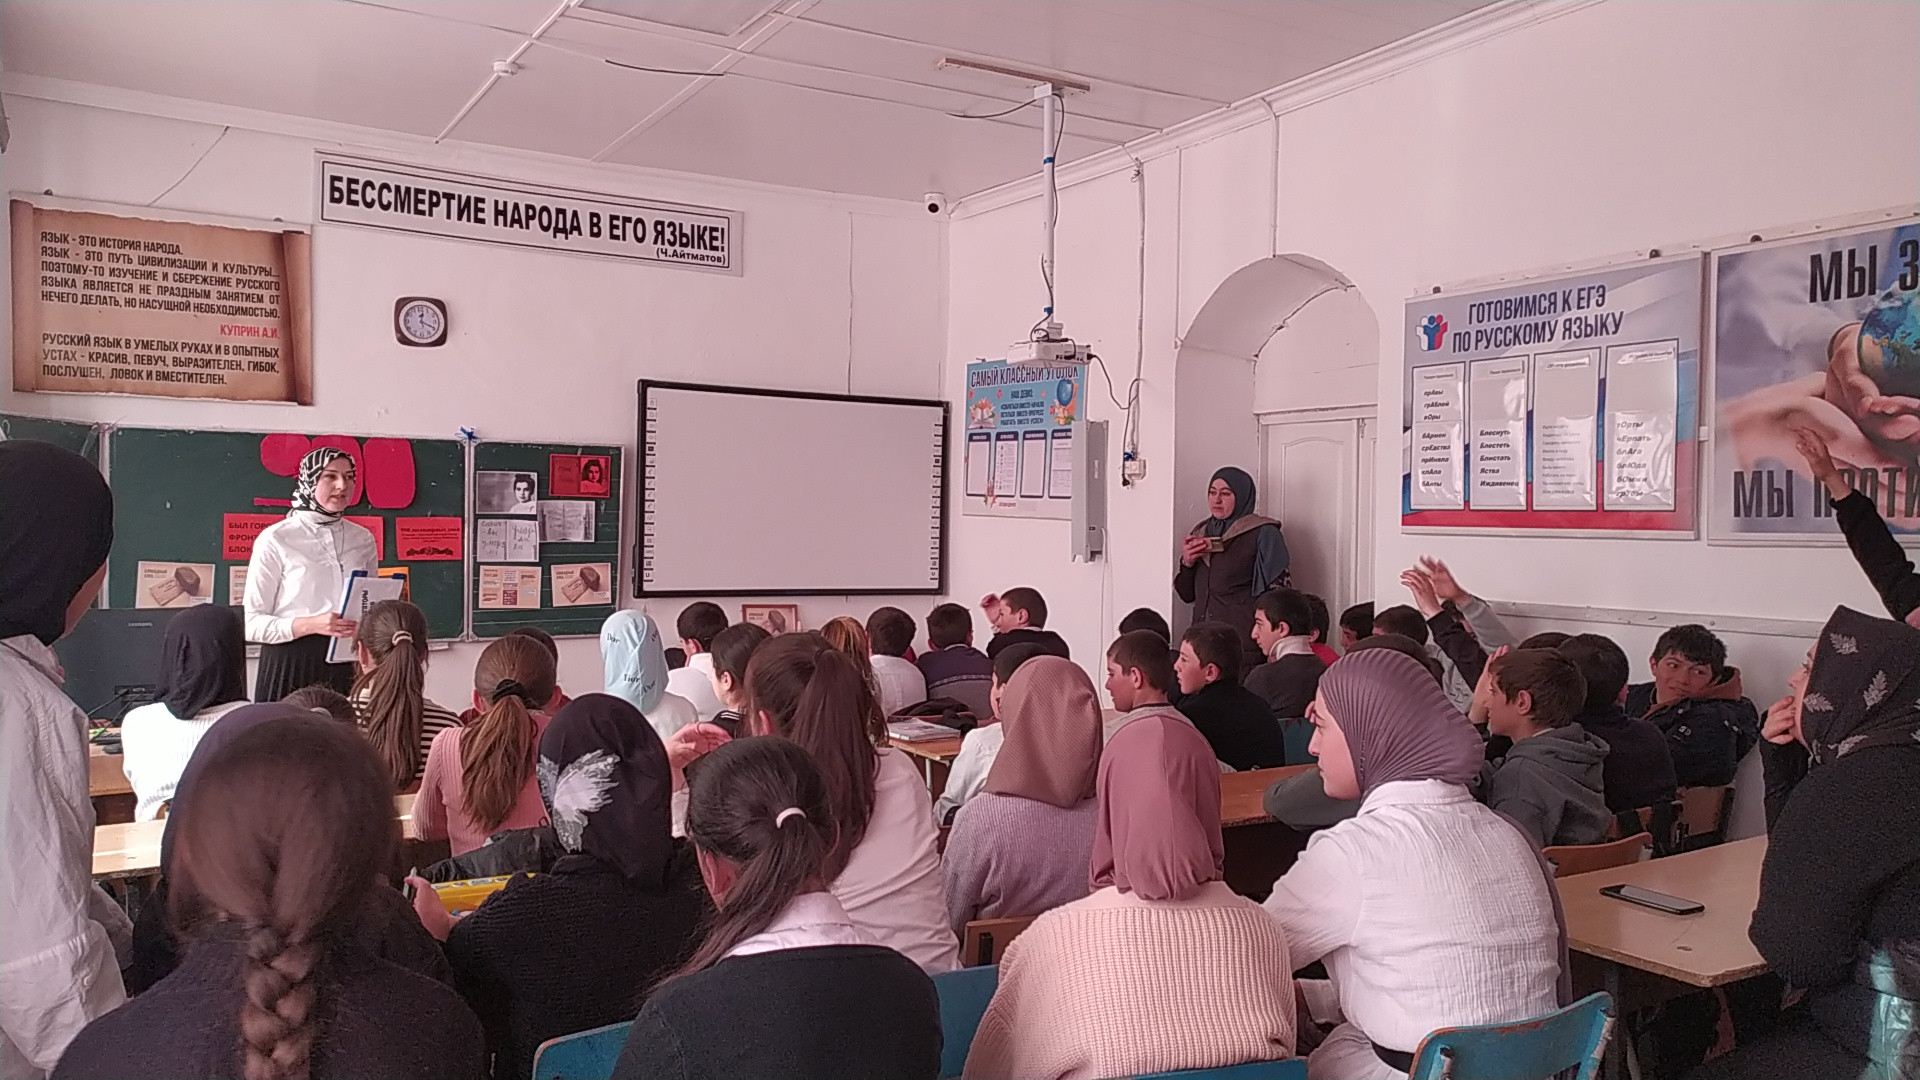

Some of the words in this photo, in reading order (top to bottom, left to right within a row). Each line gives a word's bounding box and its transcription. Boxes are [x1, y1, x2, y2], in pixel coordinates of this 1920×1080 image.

[329, 174, 486, 225] БЕССМЕРТИЕ
[494, 199, 583, 240] НАРОДА
[589, 211, 601, 238] В
[609, 214, 646, 244] ЕГО
[653, 220, 725, 252] ЯЗЫКЕ!
[41, 231, 70, 244] ЯЗЫК
[78, 235, 97, 247] ЭТО
[99, 237, 141, 251] ИСТОРИЯ
[143, 241, 183, 255] НАРОДА.
[656, 247, 726, 265] (Ч.Айтматов)
[41, 246, 70, 259] ЯЗЫК
[84, 250, 103, 262] ЭТО
[108, 252, 133, 264] ПУТЬ
[138, 255, 207, 271] ЦИВИЛИЗАЦИИ
[212, 262, 218, 272] И
[41, 261, 105, 276] ПОЭТОМУ-ТО
[109, 267, 159, 281] ИЗУЧЕНИЕ
[162, 271, 168, 282] И
[173, 272, 232, 287] СБЕРЕЖЕНИЕ
[236, 278, 280, 291] РУССКОГО
[1809, 245, 1877, 303] МЫ
[41, 276, 77, 289] ЯЗЫКА
[83, 280, 133, 293] ЯВЛЯЕТСЯ
[139, 284, 151, 295] НЕ
[157, 285, 211, 299] ПРАЗДНЫМ
[216, 290, 264, 303] ЗАНЯТИЕМ
[269, 294, 280, 305] ОТ
[41, 291, 78, 303] НЕЧЕГО
[80, 294, 122, 308] ДЕЛАТЬ,
[124, 297, 137, 308] НО
[139, 298, 191, 312] НАСУЩНОЙ
[193, 303, 280, 319] НЕОБХОДИМОСТЬЮ.
[1469, 291, 1558, 325] ГОТОВИМСЯ
[1562, 289, 1573, 312] К
[1576, 285, 1606, 310] ЕГЭ
[42, 333, 91, 347] РУССКИЙ
[93, 336, 122, 349] ЯЗЫК
[125, 338, 131, 349] В
[133, 339, 179, 352] УМЕЛЫХ
[181, 342, 213, 354] РУКАХ
[215, 344, 221, 355] И
[224, 345, 230, 355] В
[232, 345, 279, 358] ОПЫТНЫХ
[220, 325, 260, 337] КУПРИН
[262, 327, 280, 339] А.И.
[1453, 331, 1471, 353] ПО
[1475, 320, 1559, 351] РУССКОМУ
[1562, 311, 1624, 340] ЯЗЫКУ
[42, 364, 105, 379] ПОСЛУШЕН,
[110, 368, 143, 380] ЛОВОК
[146, 370, 153, 380] И
[155, 370, 227, 385] ВМЕСТИТЕЛЕН.
[43, 349, 77, 361] УСТАХ
[88, 351, 131, 365] КРАСИВ,
[134, 354, 168, 367] ПЕВУЧ,
[172, 356, 245, 372] ВЫРАЗИТЕЛЕН,
[248, 361, 279, 374] ГИБОК,
[971, 367, 998, 387] САМЫЙ
[1000, 366, 1043, 384] КЛАССНЫЙ
[1733, 470, 1794, 518] МЫ
